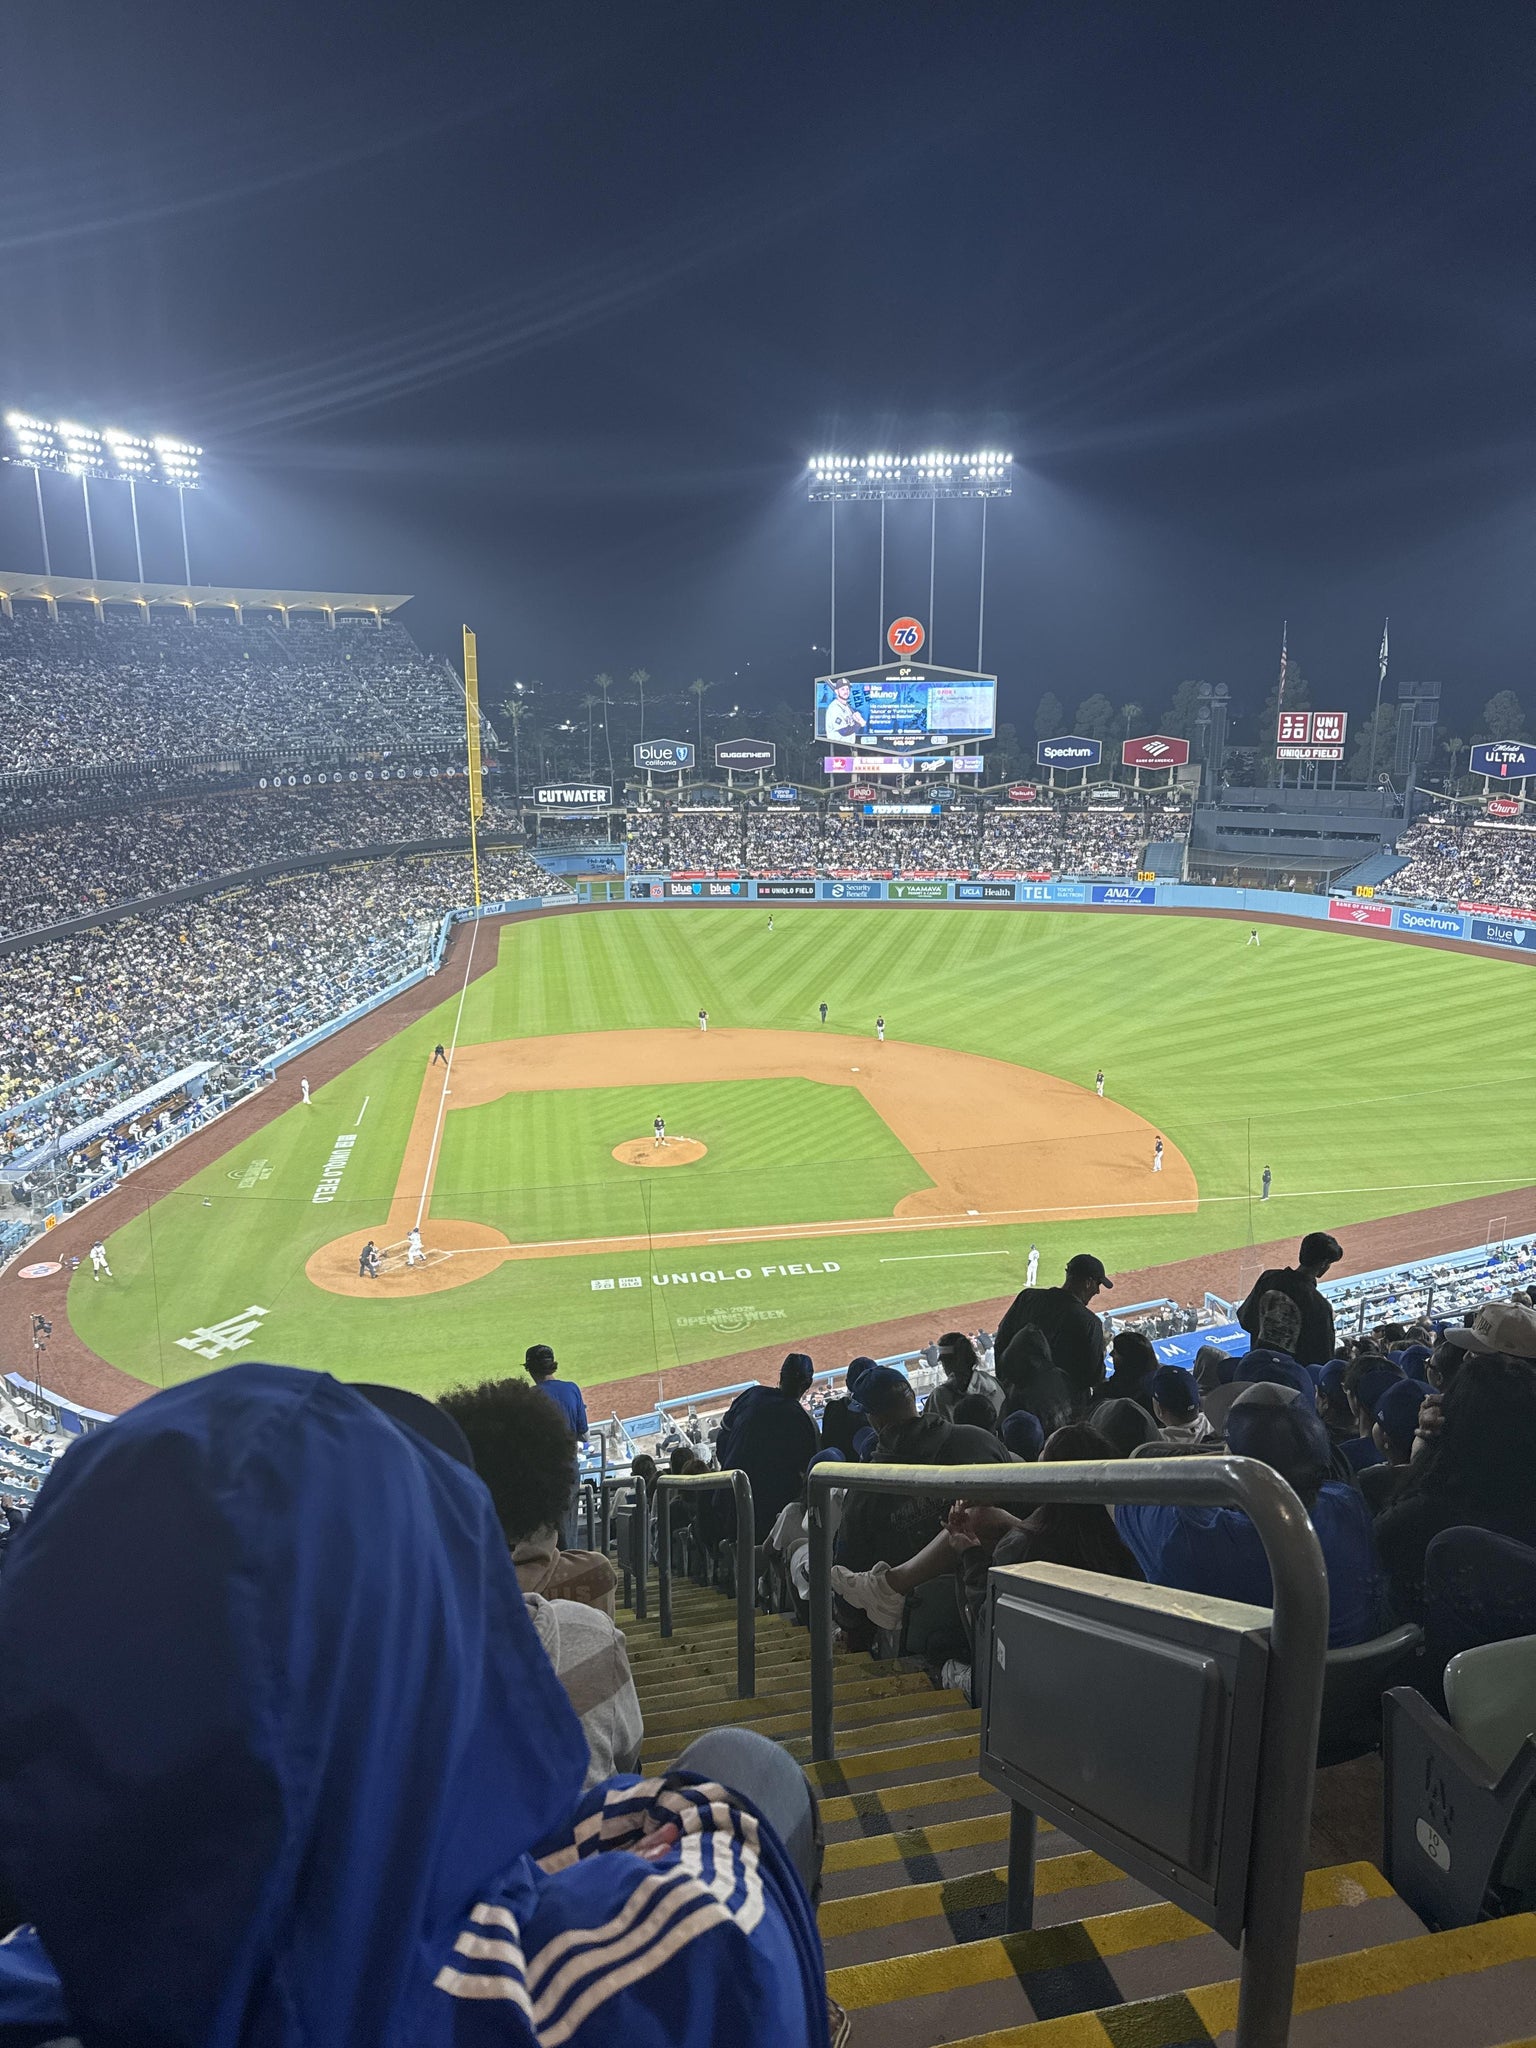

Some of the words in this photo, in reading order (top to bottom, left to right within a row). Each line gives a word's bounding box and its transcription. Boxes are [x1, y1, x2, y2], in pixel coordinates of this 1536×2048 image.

[894, 626, 919, 646] 76
[870, 690, 898, 700] Muncy
[1316, 717, 1338, 728] UNI
[1316, 728, 1339, 740] QLO
[640, 746, 673, 760] blue
[1044, 747, 1091, 759] Spectrum
[1280, 748, 1311, 758] UNIQLO
[1313, 749, 1338, 758] FIELD
[1485, 751, 1525, 763] ULTRA
[538, 789, 606, 803] CUTWATER
[853, 788, 871, 797] JINRO
[1489, 802, 1518, 814] Churu
[1137, 872, 1155, 882] 0:08
[671, 883, 692, 892] blue
[710, 883, 731, 892] blue
[846, 884, 871, 892] Security
[985, 887, 1010, 896] Health
[1023, 887, 1051, 899] TEL
[1104, 888, 1129, 898] ANA
[1356, 885, 1374, 898] 0:08
[1361, 904, 1386, 913] AMERICA
[1402, 912, 1455, 931] Spectrum
[1487, 925, 1513, 939] blue
[1486, 935, 1512, 943] CALIFORNIA
[322, 1149, 352, 1177] UNIQLO
[312, 1178, 341, 1203] FIELD
[652, 1268, 752, 1286] UNIQLO
[761, 1261, 841, 1277] FIELD
[676, 1313, 743, 1326] OPENING
[744, 1309, 787, 1321] WEEK
[172, 1304, 272, 1360] LA
